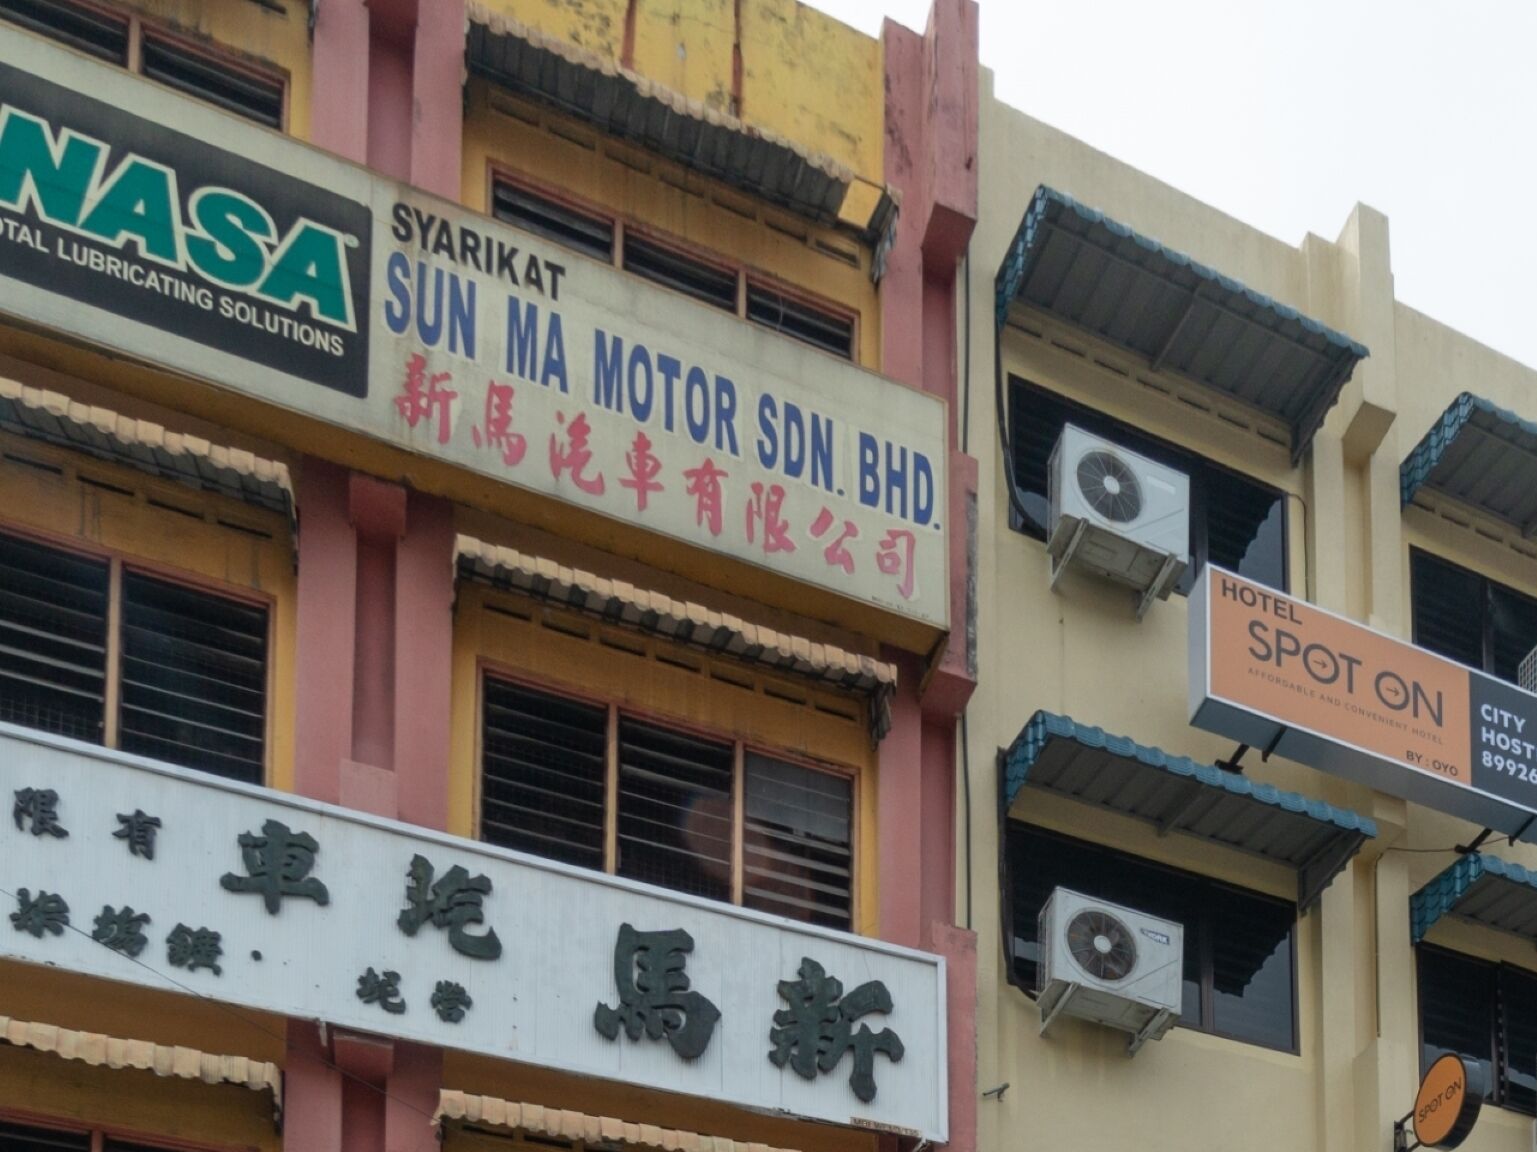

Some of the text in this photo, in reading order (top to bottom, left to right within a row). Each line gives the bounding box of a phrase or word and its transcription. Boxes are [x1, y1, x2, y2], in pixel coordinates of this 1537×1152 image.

[391, 202, 565, 301] SYARIKAT
[58, 237, 213, 312] LUBRICATING
[219, 296, 345, 356] SOLUTIONS
[385, 251, 941, 531] SUN MA MOTOR SDN. BHD.
[1221, 578, 1303, 625] HOTEL
[1247, 619, 1444, 728] SPOT ON
[1247, 667, 1444, 745] AFFORDABLE AND CONVENIENT HOTEL
[1480, 703, 1526, 733] CITY
[1405, 750, 1459, 777] BY OYO
[1417, 1077, 1462, 1124] SPOT ON
